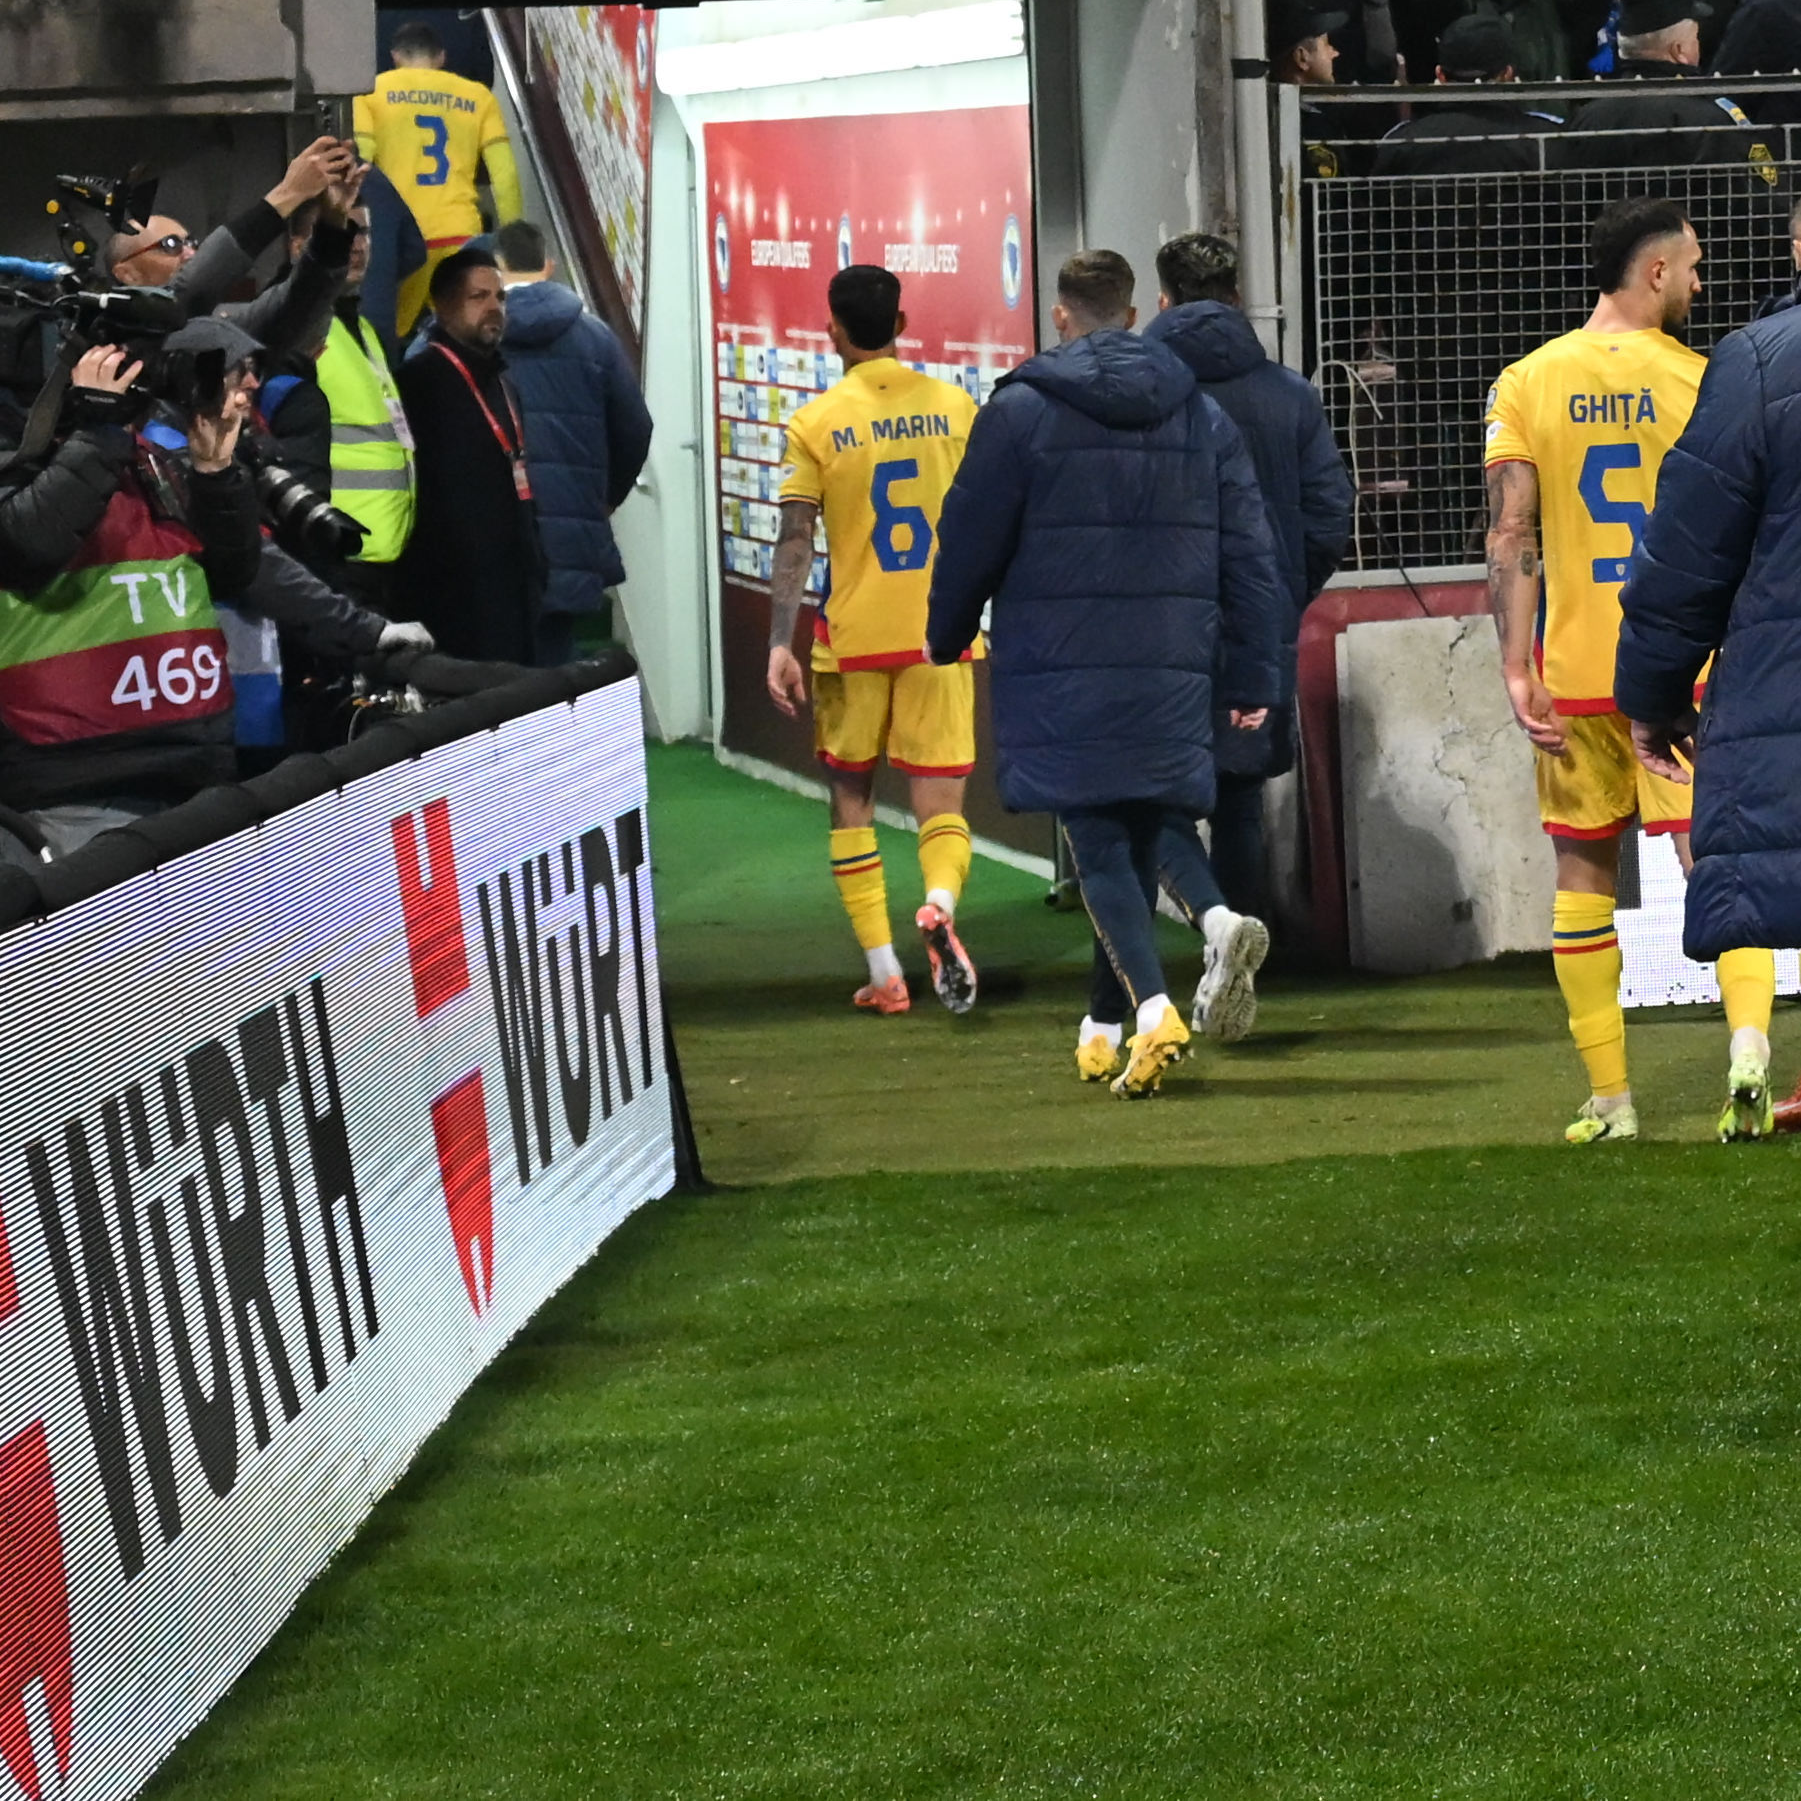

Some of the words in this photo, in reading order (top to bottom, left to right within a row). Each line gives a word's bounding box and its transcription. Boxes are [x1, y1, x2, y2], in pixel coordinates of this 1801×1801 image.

[414, 114, 449, 186] 3
[832, 426, 863, 454] M.
[871, 413, 950, 442] MARIN
[1568, 386, 1656, 432] GHIȚĂ
[870, 458, 933, 573] 6
[1577, 442, 1646, 584] 5
[110, 568, 188, 625] TV
[111, 645, 222, 712] 469
[24, 974, 380, 1584] WÜRTH
